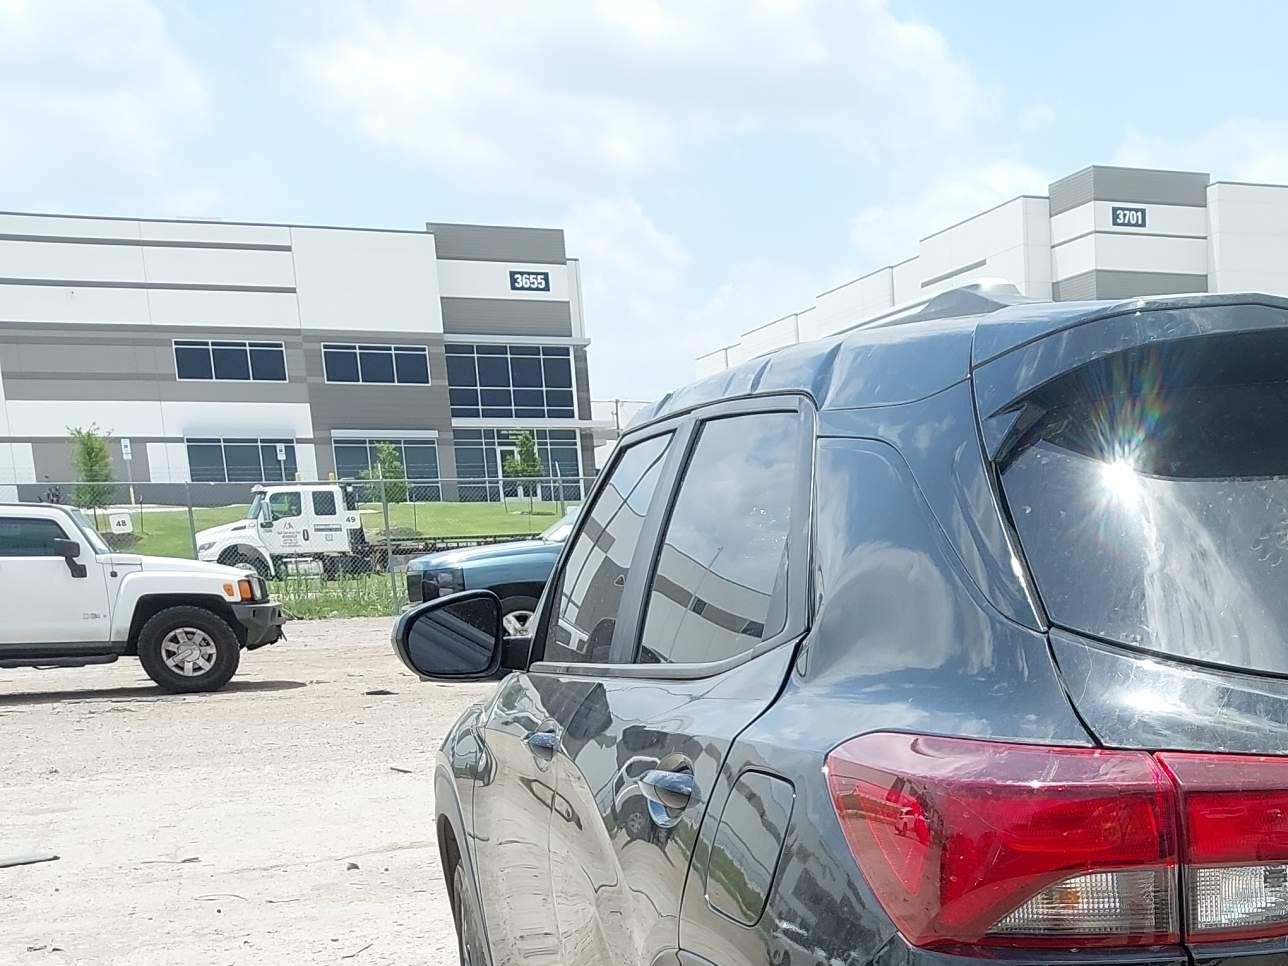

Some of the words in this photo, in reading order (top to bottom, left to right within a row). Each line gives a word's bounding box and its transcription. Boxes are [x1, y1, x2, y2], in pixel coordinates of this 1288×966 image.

[1116, 209, 1143, 225] 3701
[514, 274, 546, 289] 3655
[345, 516, 356, 524] 49
